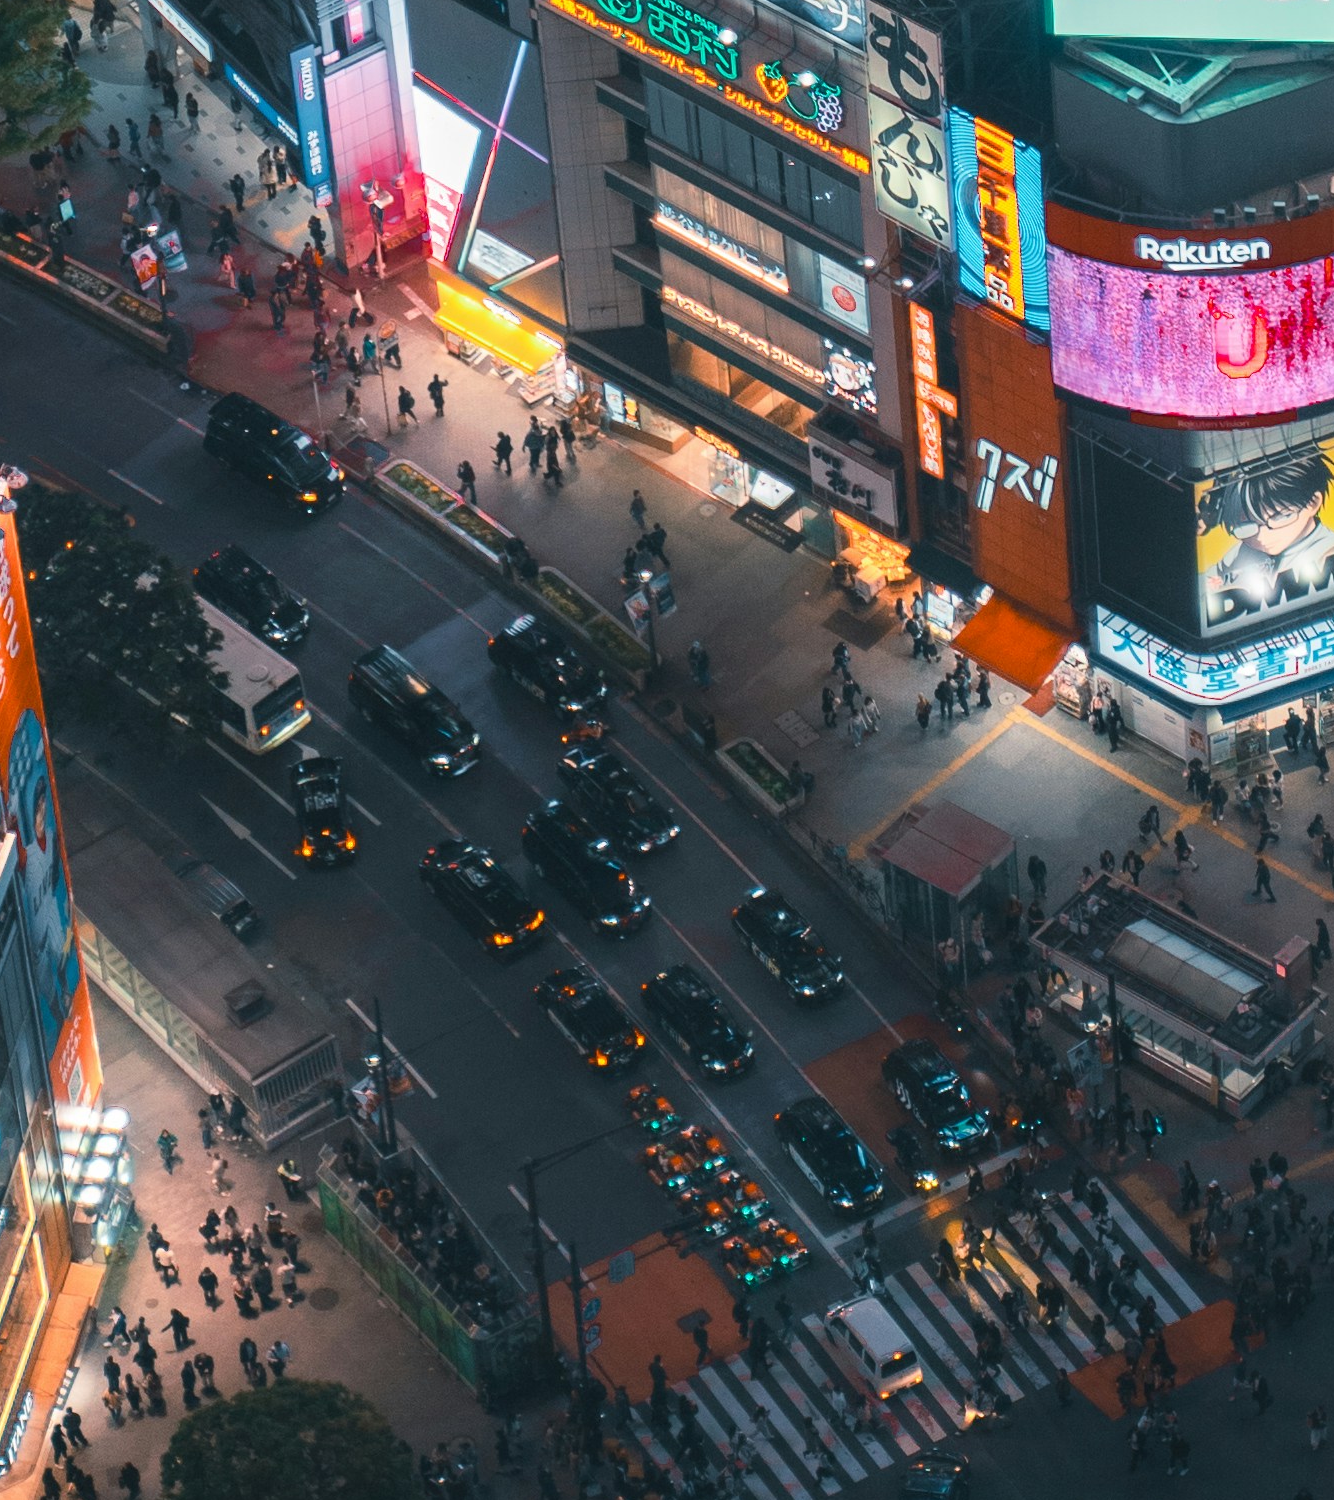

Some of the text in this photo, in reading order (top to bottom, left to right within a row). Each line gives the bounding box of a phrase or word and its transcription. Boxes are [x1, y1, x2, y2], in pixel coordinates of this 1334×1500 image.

[647, 2, 739, 81] 西村
[298, 56, 313, 101] MIZUHO
[1139, 235, 1271, 267] Rakuten
